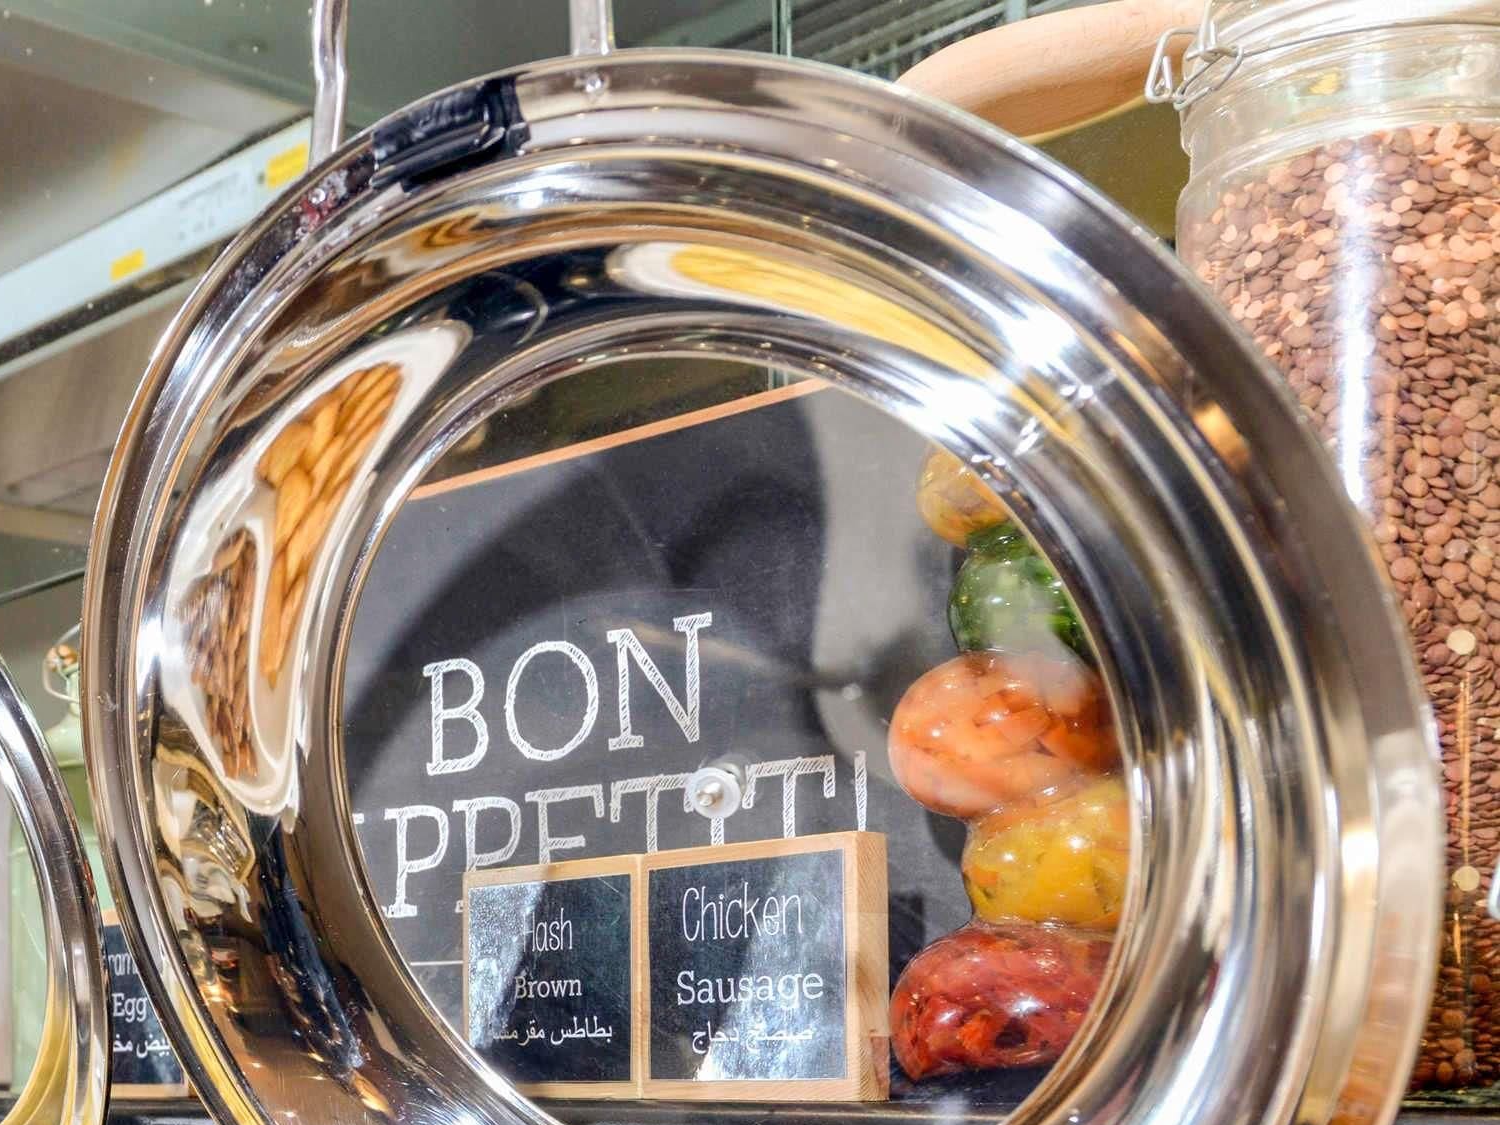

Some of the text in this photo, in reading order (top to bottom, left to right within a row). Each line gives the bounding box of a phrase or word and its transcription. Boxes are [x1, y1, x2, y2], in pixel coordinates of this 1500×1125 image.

[422, 612, 713, 776] BON
[522, 907, 574, 953] Hash
[682, 881, 804, 942] Chicken
[514, 973, 583, 1000] Brown
[676, 969, 825, 1009] Sausage
[111, 992, 148, 1023] Egg
[550, 1015, 613, 1045] بطاطس
